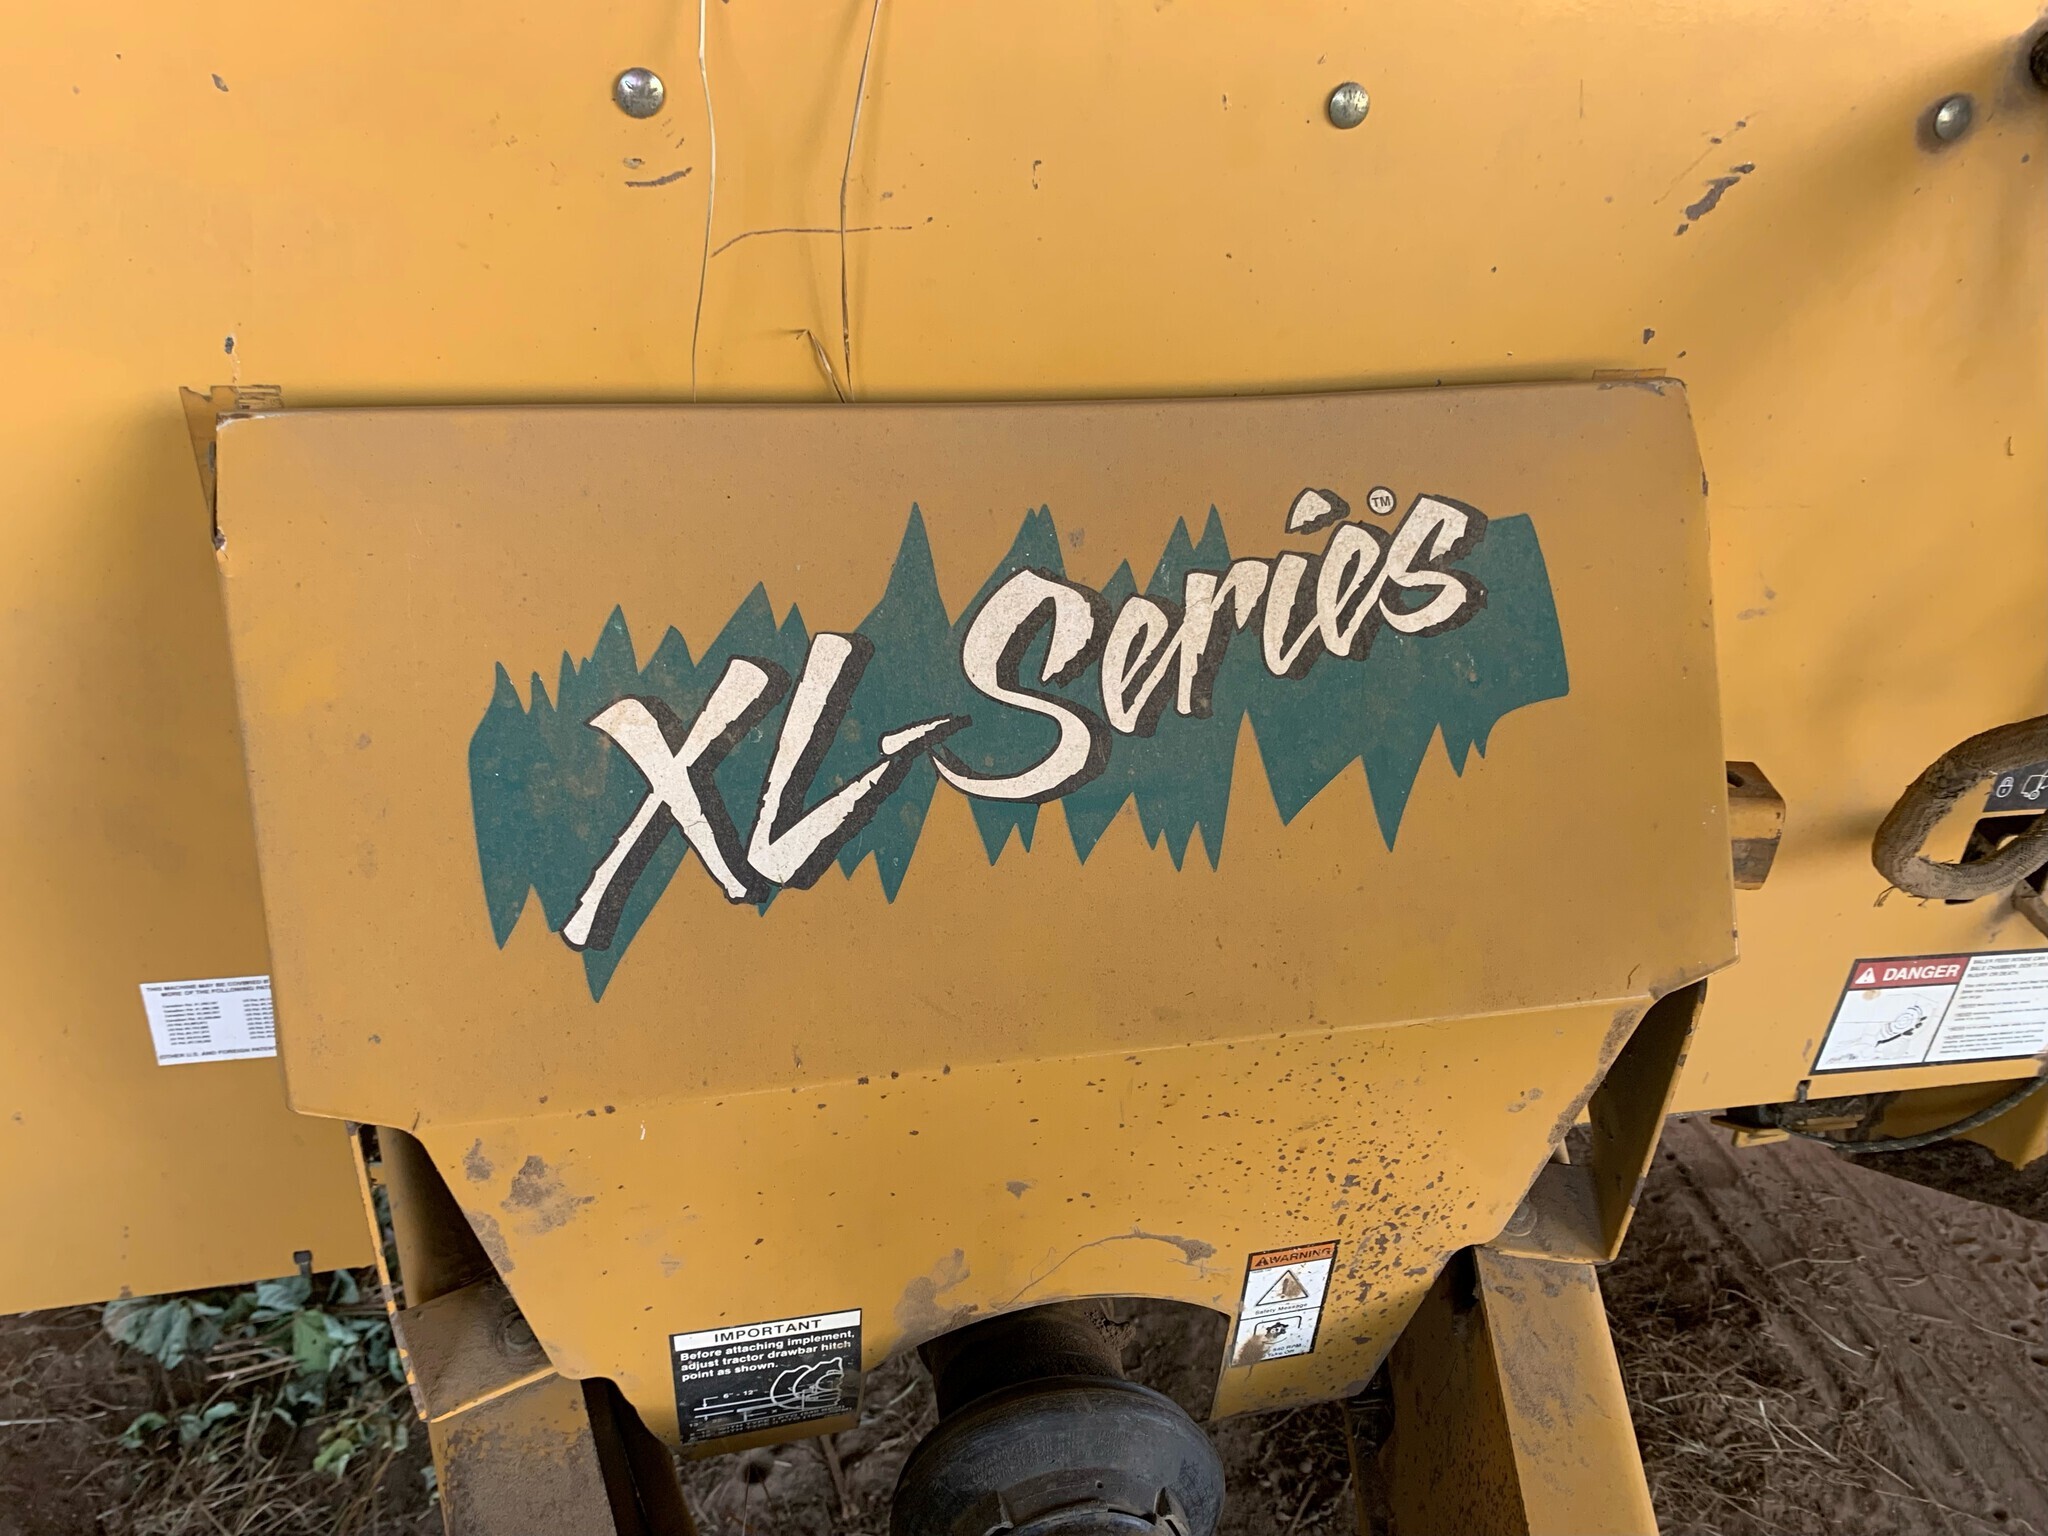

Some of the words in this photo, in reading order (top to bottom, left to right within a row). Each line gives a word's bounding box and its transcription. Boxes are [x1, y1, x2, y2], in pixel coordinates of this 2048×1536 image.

[1371, 496, 1391, 507] TM
[931, 488, 1488, 804] Series
[1882, 964, 1961, 982] DANGER
[1269, 1247, 1332, 1264] WARNING
[1255, 1308, 1277, 1316] Safety
[1278, 1303, 1308, 1312] Message
[714, 1319, 822, 1343] IMPORTANT
[680, 1348, 722, 1361] Before
[725, 1339, 785, 1355] attaching
[787, 1329, 855, 1346] implement,
[681, 1357, 720, 1373] adjust
[722, 1352, 764, 1366] tractor
[767, 1345, 818, 1359] drawbar
[821, 1339, 852, 1352] hitch
[682, 1369, 715, 1382] point
[717, 1367, 732, 1376] as
[734, 1361, 779, 1374] shown.
